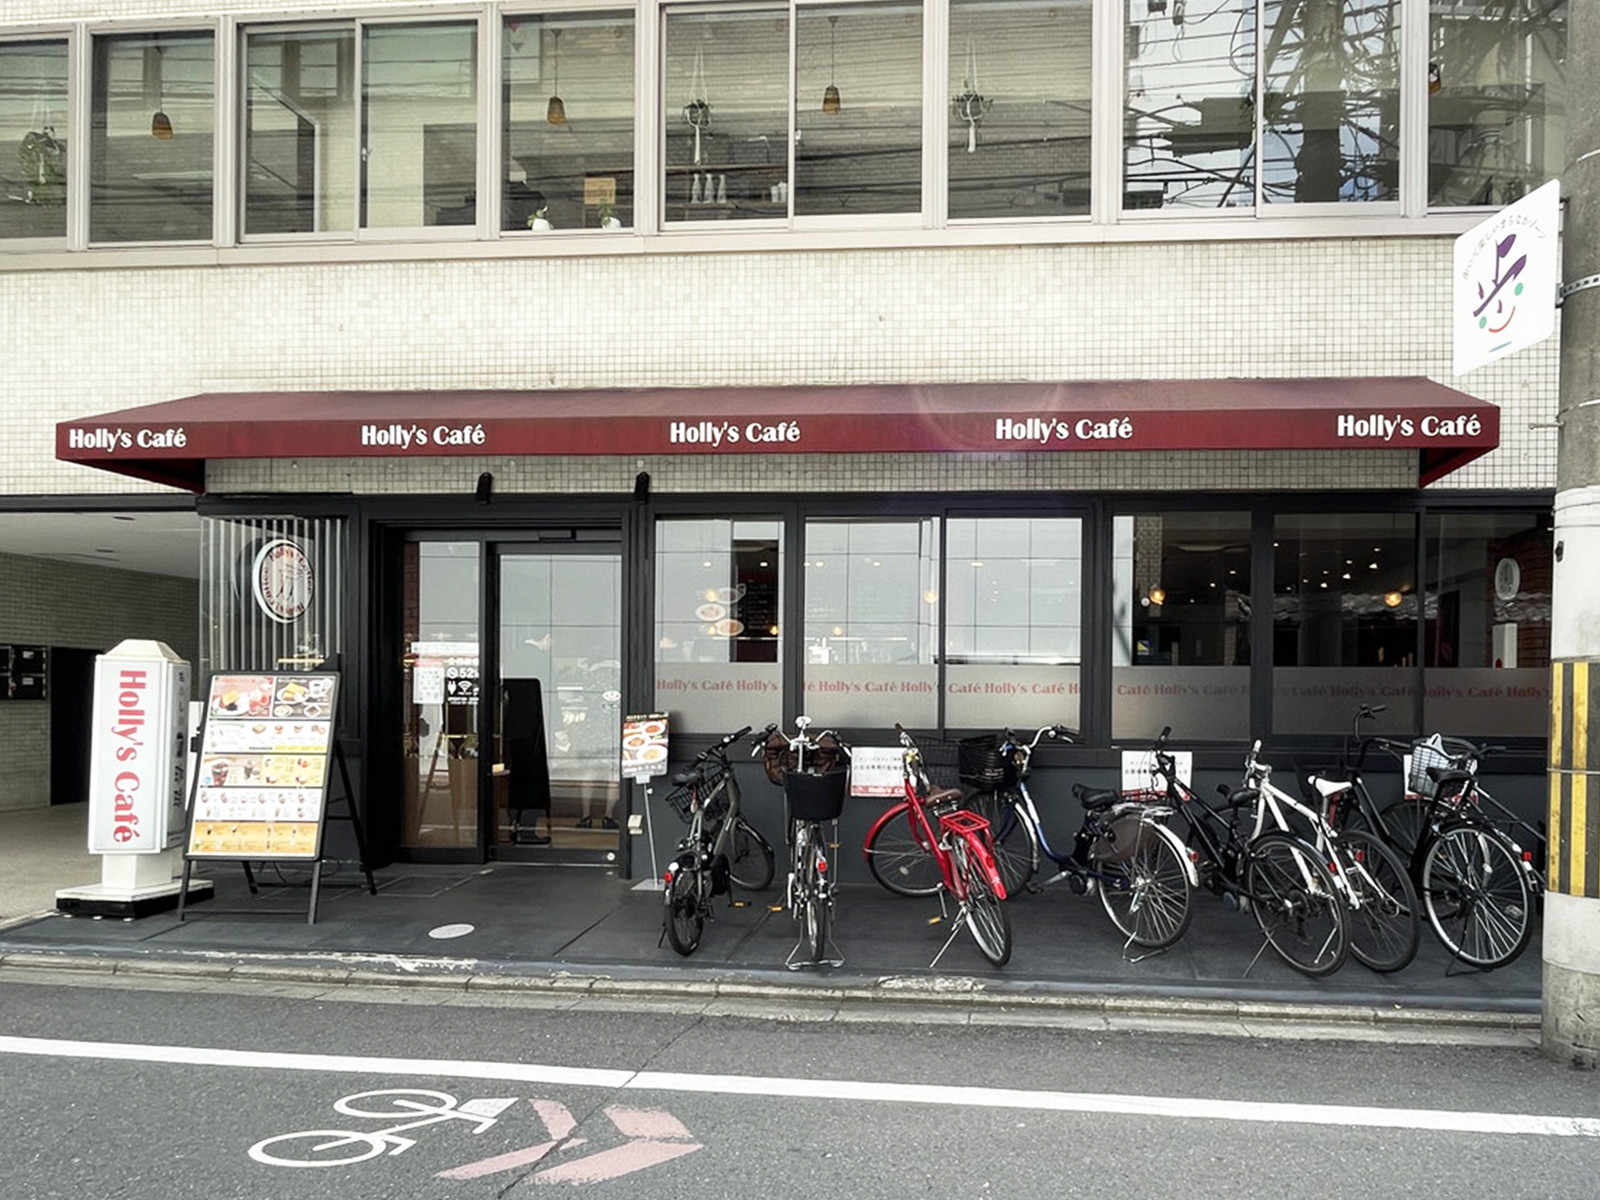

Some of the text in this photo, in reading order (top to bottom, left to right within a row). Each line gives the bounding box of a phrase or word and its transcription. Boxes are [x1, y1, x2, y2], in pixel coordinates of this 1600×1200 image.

[70, 427, 186, 452] Holly's Café
[362, 423, 485, 450] Holly's Café
[670, 420, 801, 448] Holly's Café
[995, 416, 1133, 444] Holly's Café
[1337, 413, 1481, 441] Holly's Café
[656, 678, 778, 695] Holly's Café Holly's
[819, 680, 861, 695] Holly's
[864, 680, 898, 693] Café
[947, 681, 982, 694] Café
[985, 681, 1028, 698] Holly's
[1031, 681, 1066, 694] Café
[1117, 683, 1151, 696] Café
[1154, 683, 1199, 698] Holly's
[111, 670, 147, 842] Holly's Café
